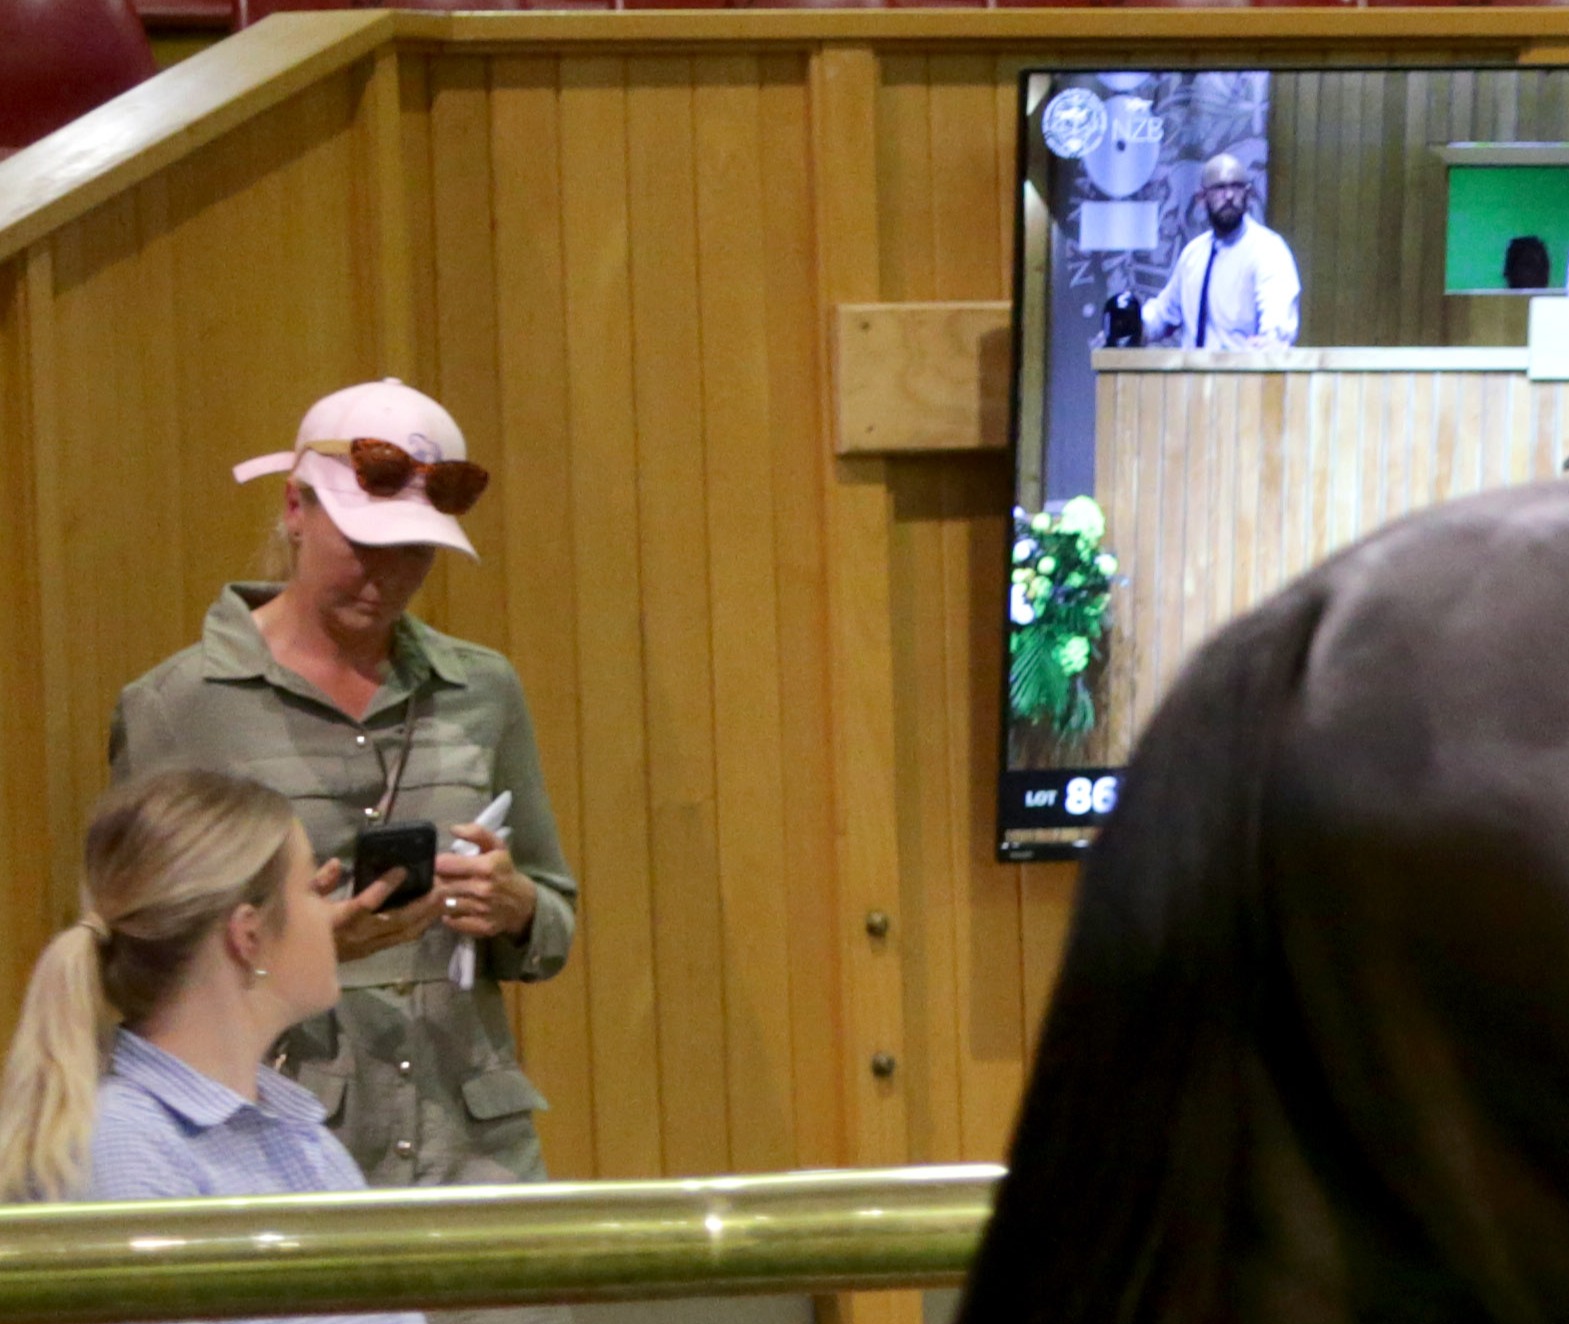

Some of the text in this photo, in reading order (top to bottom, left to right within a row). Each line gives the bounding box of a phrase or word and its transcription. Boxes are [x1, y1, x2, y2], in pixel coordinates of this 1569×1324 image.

[1111, 116, 1165, 143] NZB
[1025, 775, 1120, 815] LOT 86
